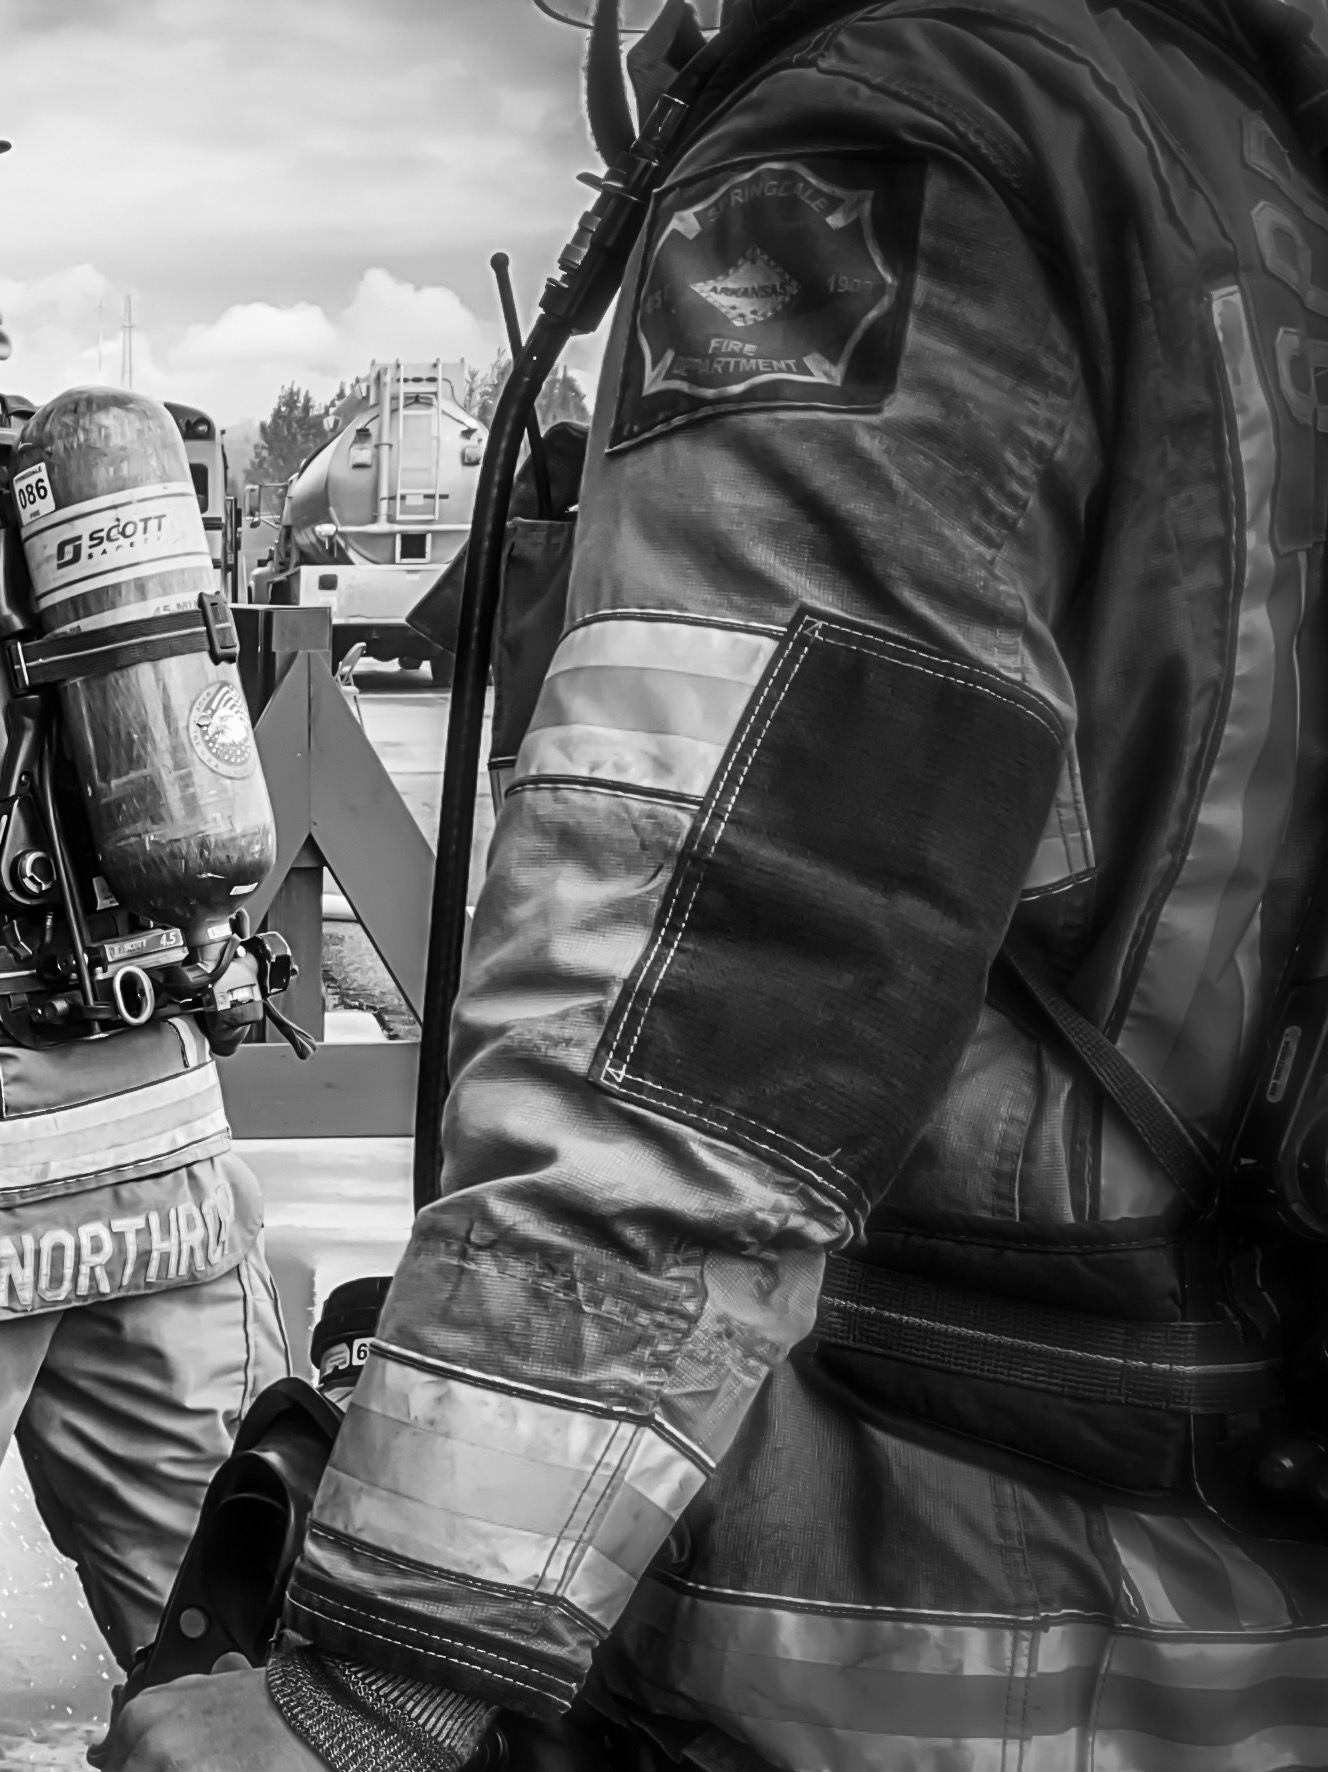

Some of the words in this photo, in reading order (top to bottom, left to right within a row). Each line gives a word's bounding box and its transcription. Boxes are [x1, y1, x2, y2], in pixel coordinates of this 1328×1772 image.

[708, 338, 758, 356] FIRE
[18, 477, 48, 510] 086
[88, 514, 167, 549] SCOTT
